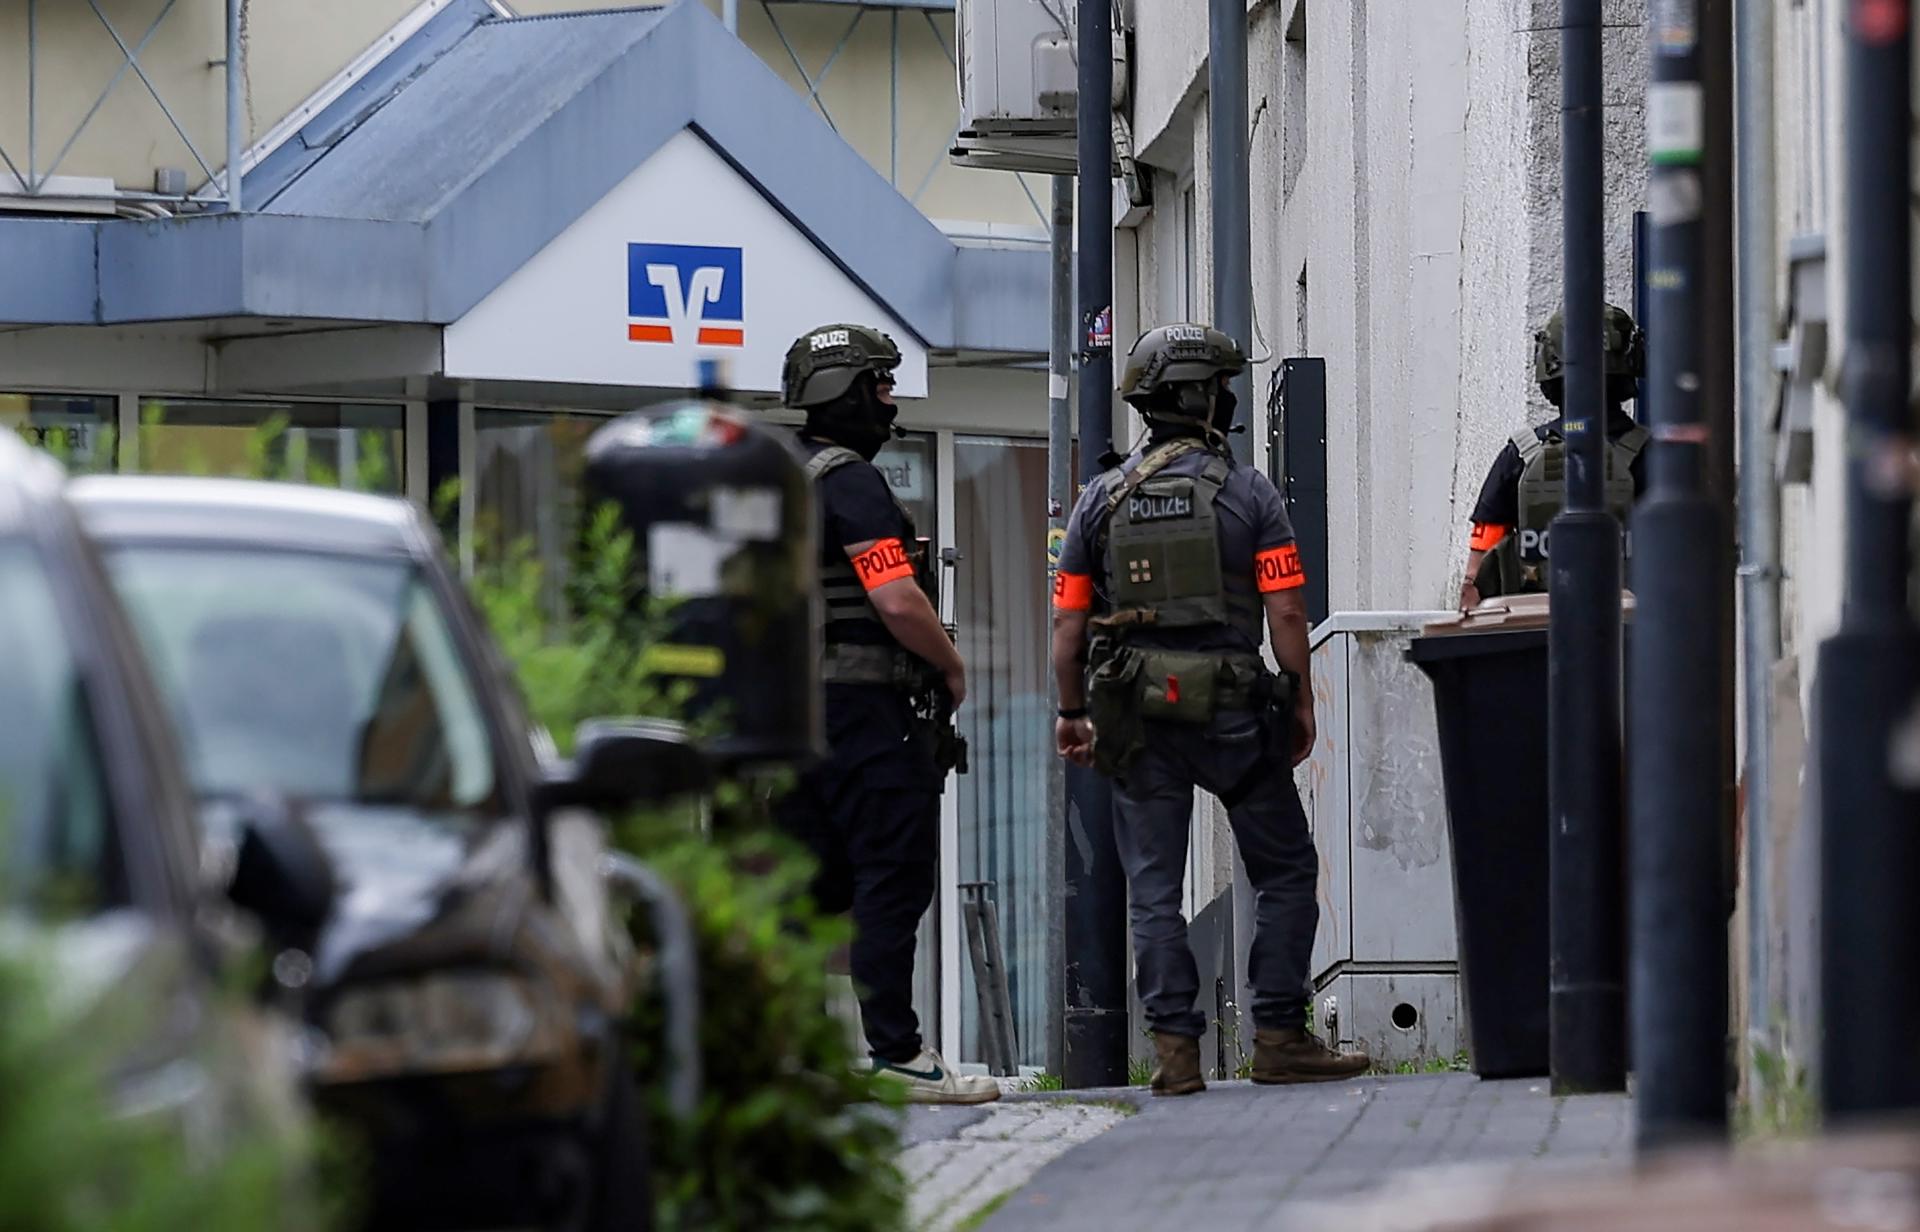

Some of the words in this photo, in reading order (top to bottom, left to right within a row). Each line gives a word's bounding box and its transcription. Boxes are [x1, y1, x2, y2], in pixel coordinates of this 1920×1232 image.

[810, 330, 850, 352] POLIZEI
[1166, 327, 1206, 342] POLIZEI
[1129, 496, 1190, 519] POLIZEI
